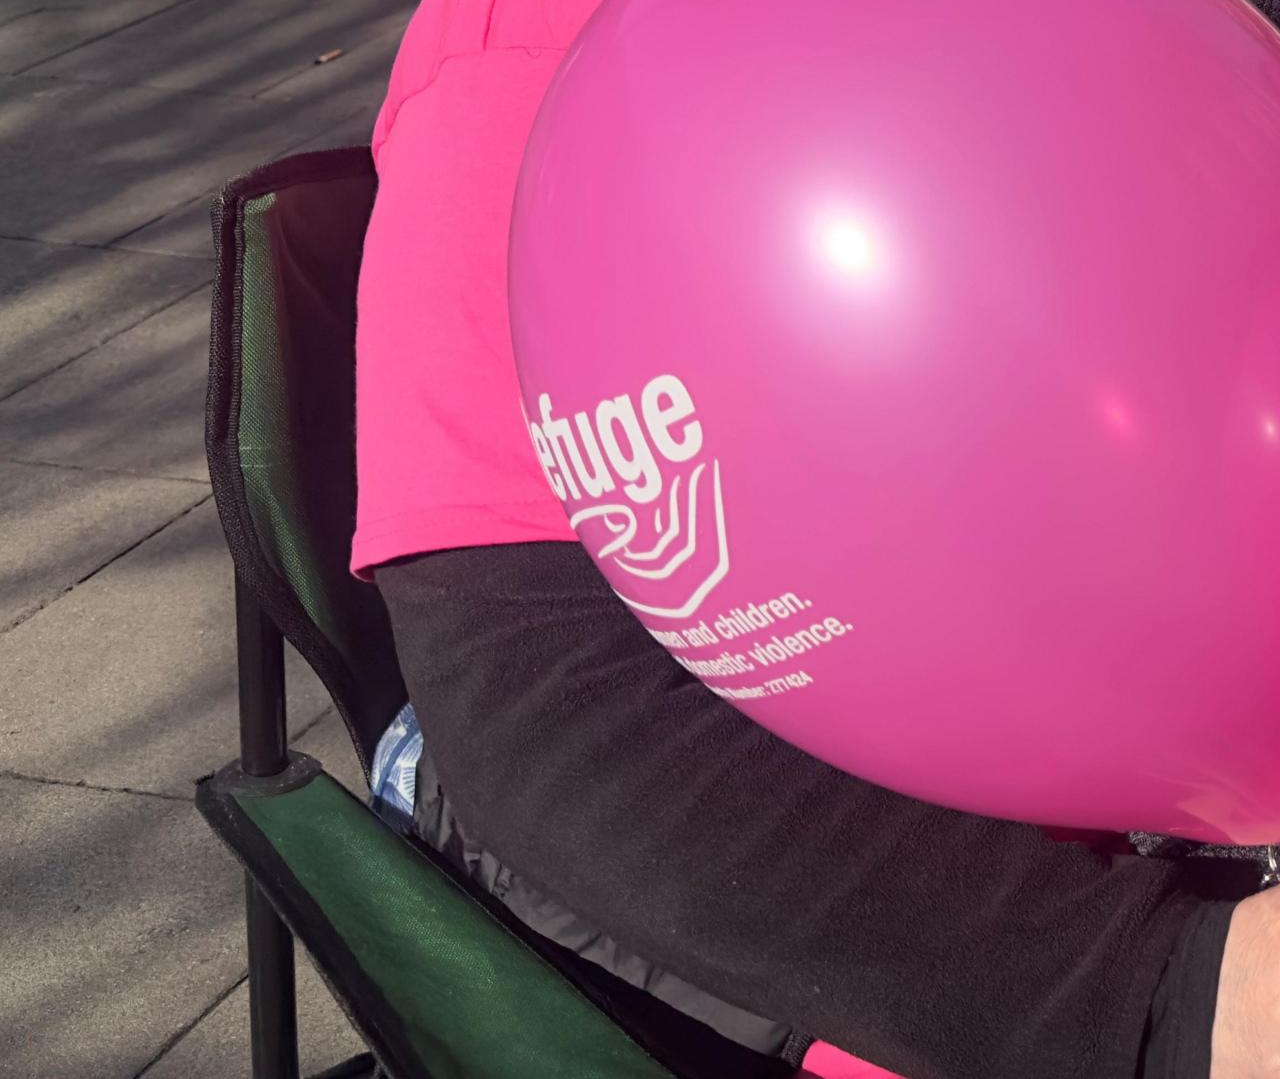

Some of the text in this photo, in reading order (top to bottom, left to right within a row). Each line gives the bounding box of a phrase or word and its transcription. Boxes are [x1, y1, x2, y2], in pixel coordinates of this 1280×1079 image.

[682, 591, 813, 648] and children.
[750, 616, 854, 667] violence.
